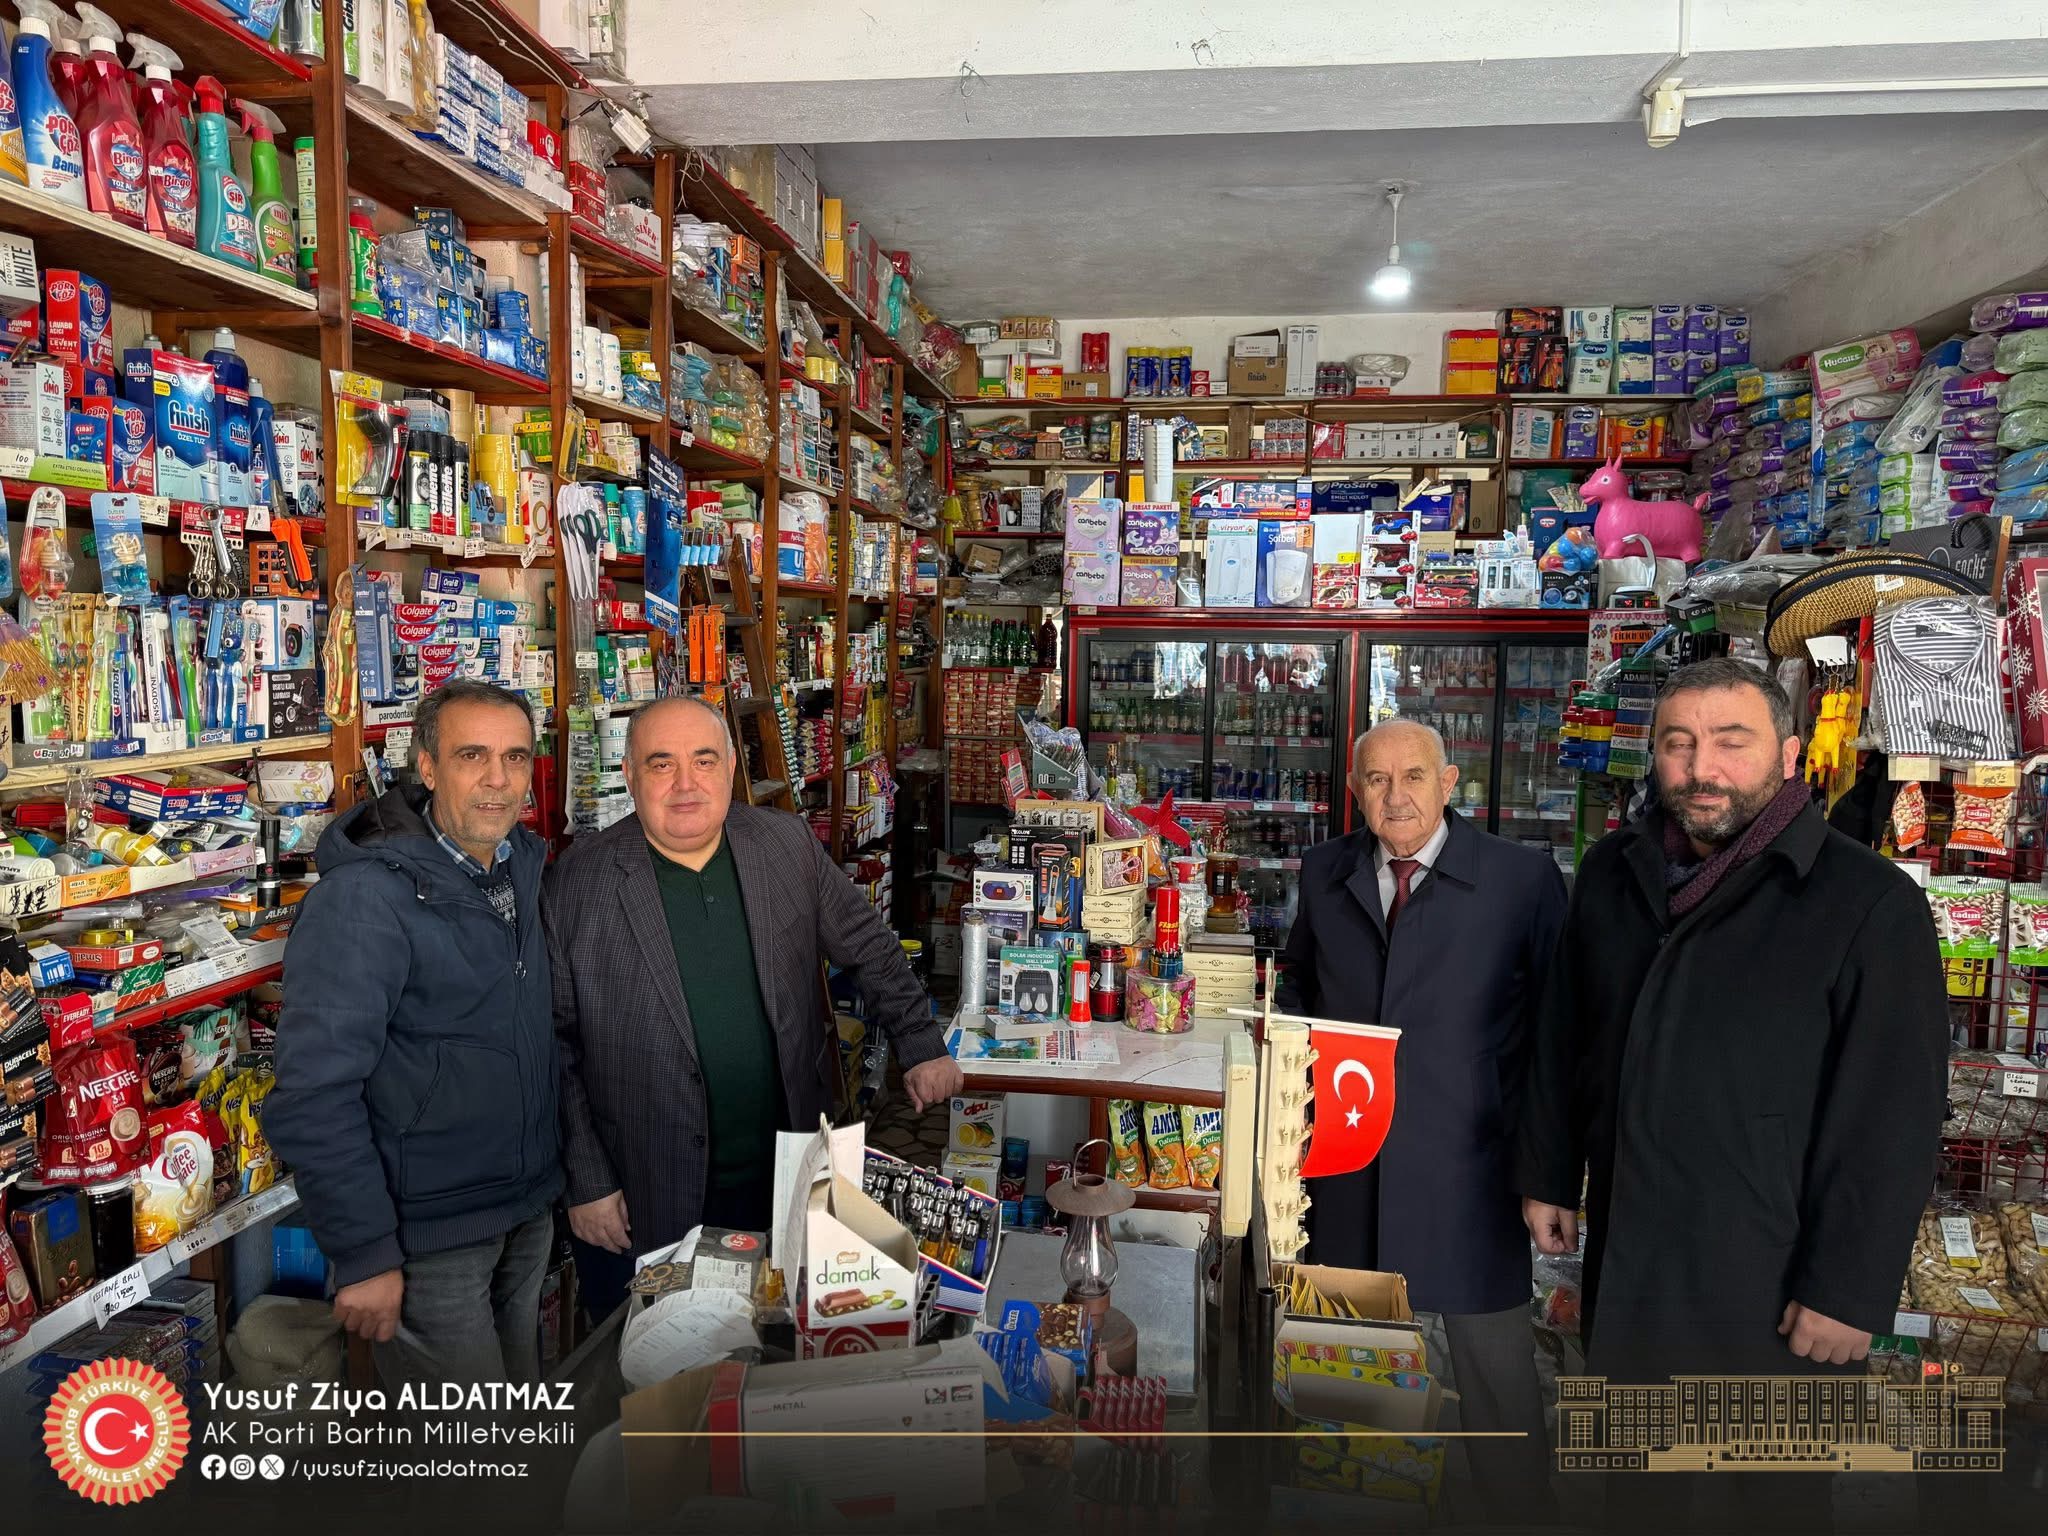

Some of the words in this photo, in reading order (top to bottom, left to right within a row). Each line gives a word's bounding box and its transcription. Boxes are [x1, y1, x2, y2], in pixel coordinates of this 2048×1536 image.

[113, 151, 144, 166] Bingo
[52, 155, 82, 178] Banyo
[111, 179, 124, 189] TOZ
[164, 175, 192, 189] Bingo
[14, 246, 36, 289] WHITE
[1824, 353, 1862, 369] HUGGIES
[127, 363, 151, 377] finish
[1247, 371, 1267, 382] finish
[44, 381, 60, 395] OMO
[168, 400, 210, 433] finish
[193, 435, 206, 446] TUZ
[274, 433, 290, 445] OMO
[301, 448, 314, 463] OMO
[461, 461, 470, 503] Gibbs
[1331, 481, 1378, 490] ProSafe
[1078, 518, 1107, 527] canbebe
[1127, 520, 1158, 528] canbebe
[1219, 524, 1245, 532] vizyon
[1268, 534, 1297, 545] Şofben
[1076, 571, 1105, 580] canbebe
[1124, 571, 1153, 579] canbebe
[402, 605, 433, 617] Colgate
[400, 624, 432, 636] Colgate
[424, 646, 452, 659] Colgate
[424, 666, 453, 679] Colgate
[114, 668, 122, 705] Banat
[378, 709, 415, 721] parodontax
[1966, 809, 1991, 818] tadım
[1952, 911, 1982, 920] tadım
[75, 953, 102, 963] Small
[63, 1009, 90, 1023] EVEREADY
[4, 1047, 37, 1068] DURACELL
[154, 1074, 177, 1086] CLASSIC
[75, 1127, 107, 1140] ORIGINAL
[816, 1256, 881, 1285] damak
[773, 1402, 806, 1412] METAL
